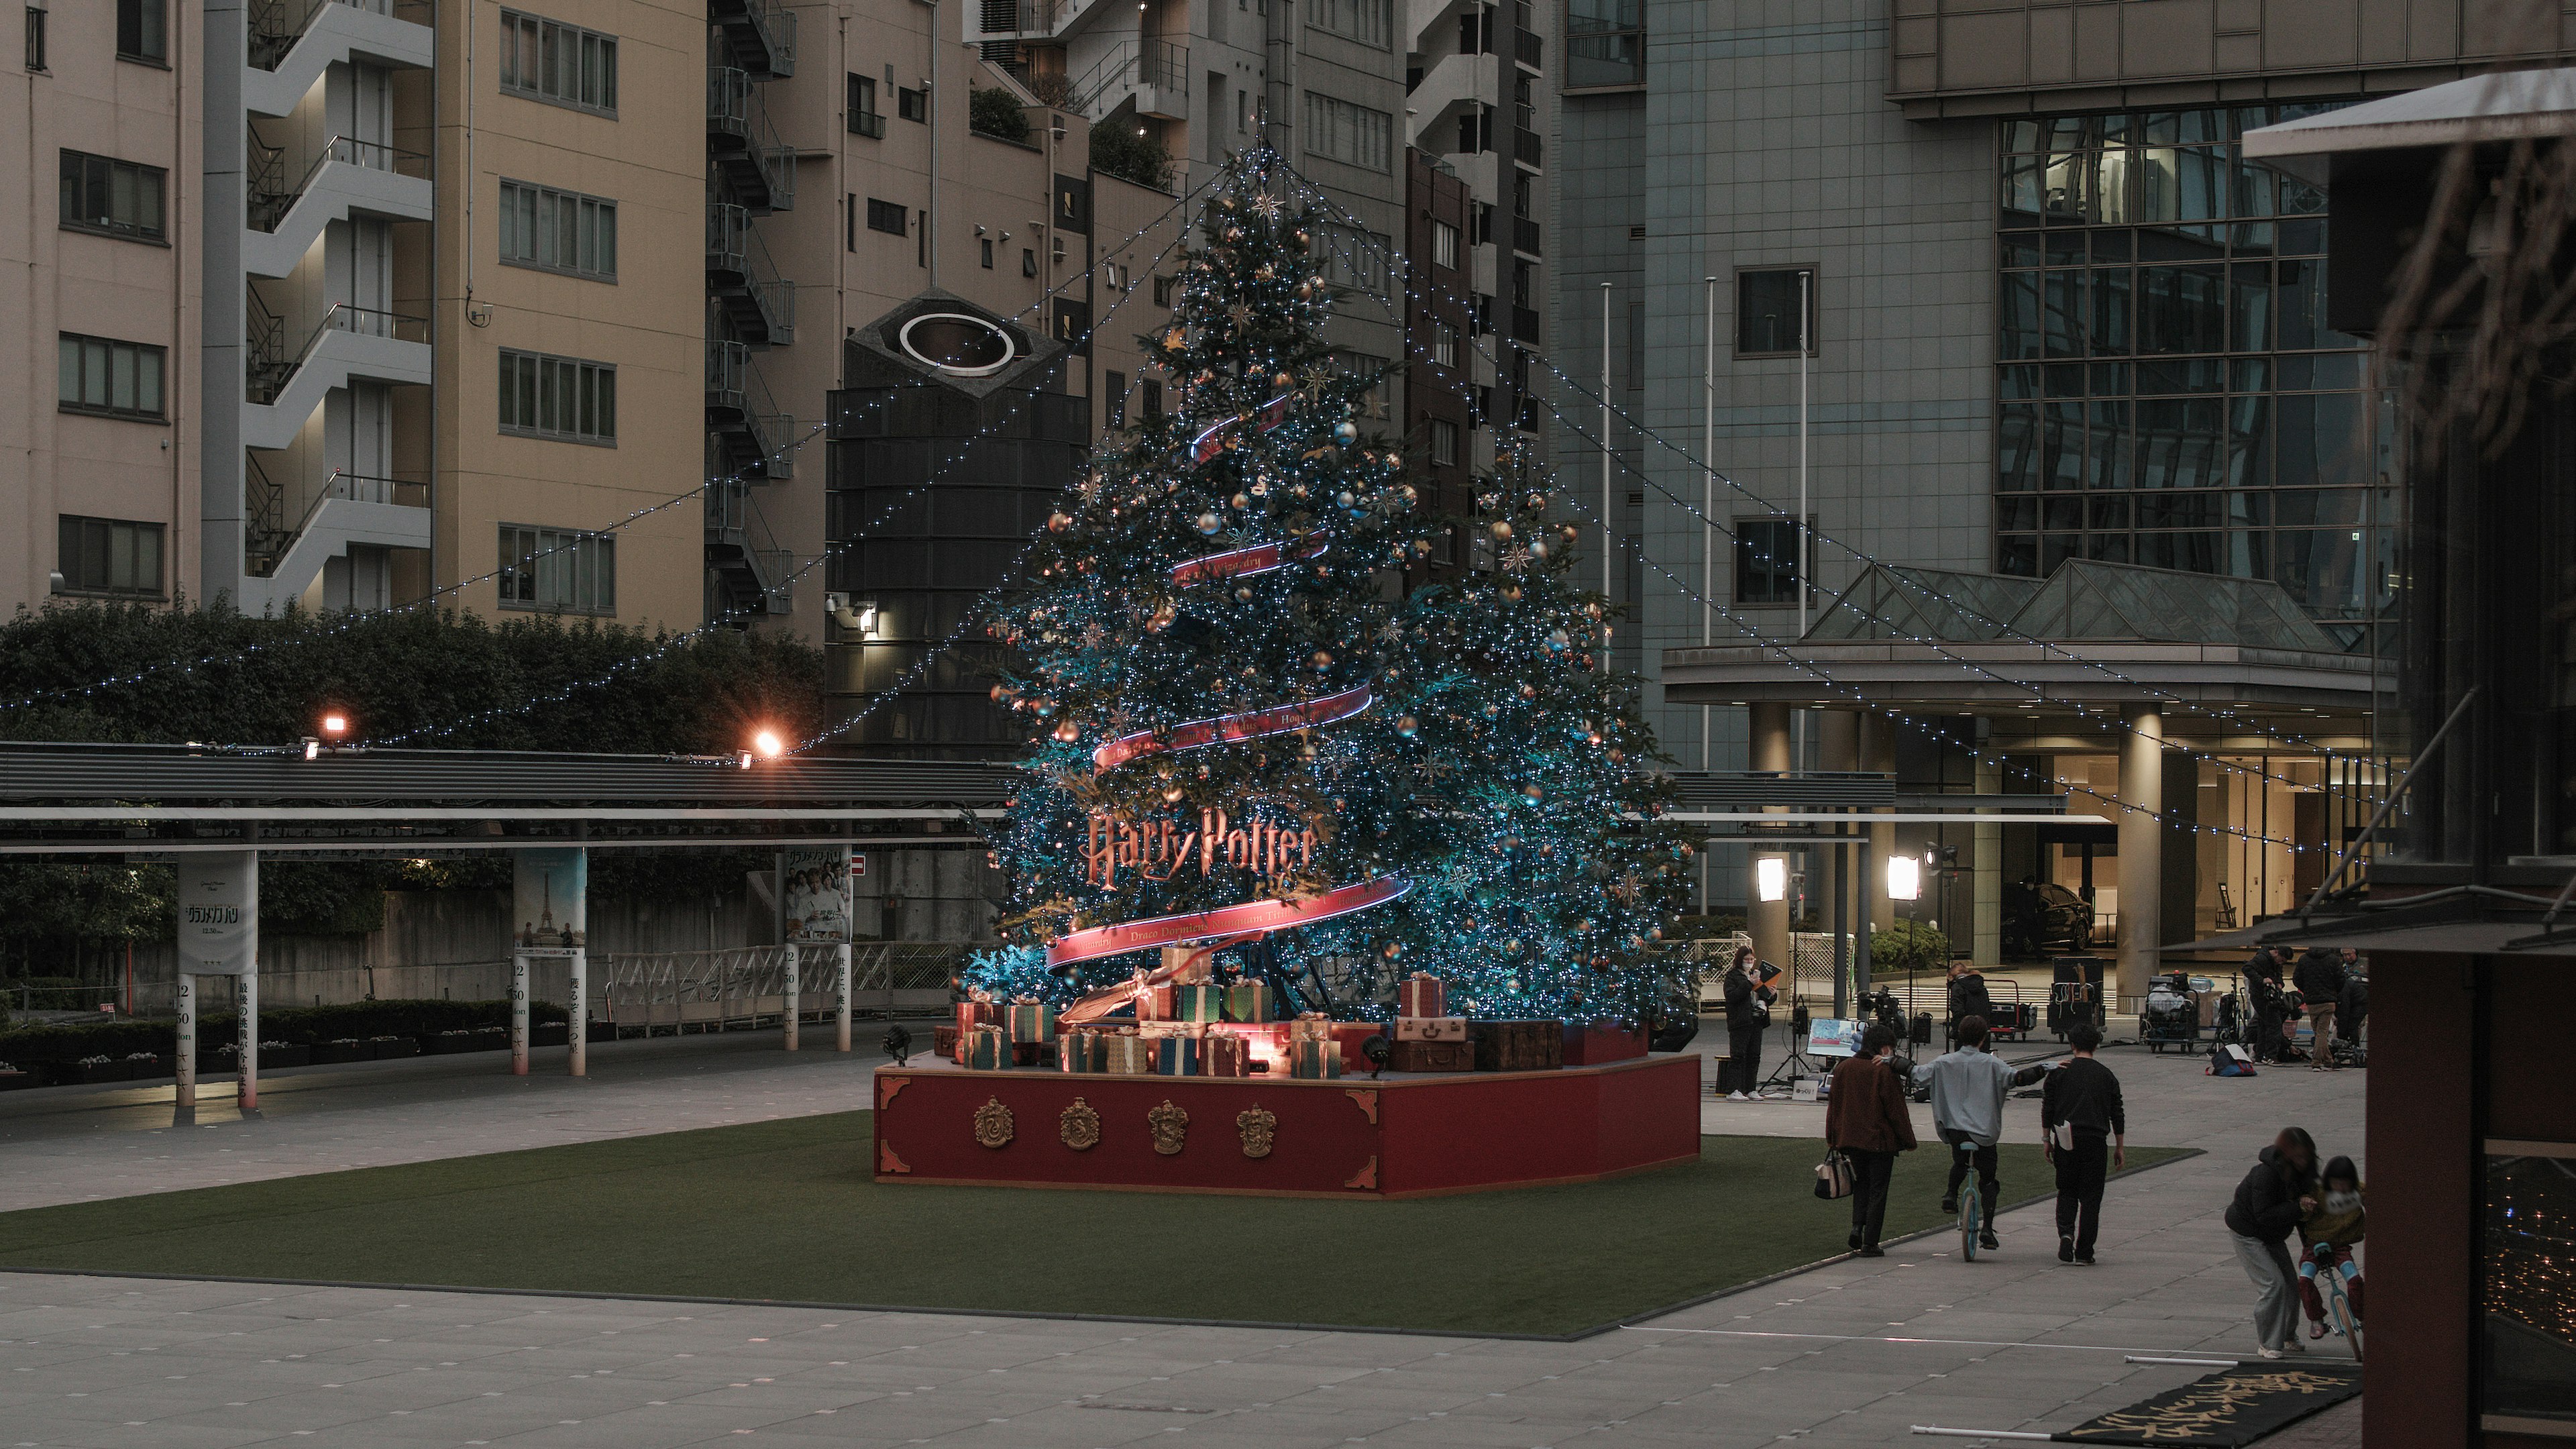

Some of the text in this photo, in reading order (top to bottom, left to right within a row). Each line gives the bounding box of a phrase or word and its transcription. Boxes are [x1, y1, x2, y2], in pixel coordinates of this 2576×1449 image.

[1078, 807, 1318, 892] Harry Potter
[1077, 936, 1112, 950] Wizardry
[1131, 930, 1158, 941] Draco
[1161, 923, 1208, 937] Dormiens
[1212, 915, 1263, 929] Nunquam
